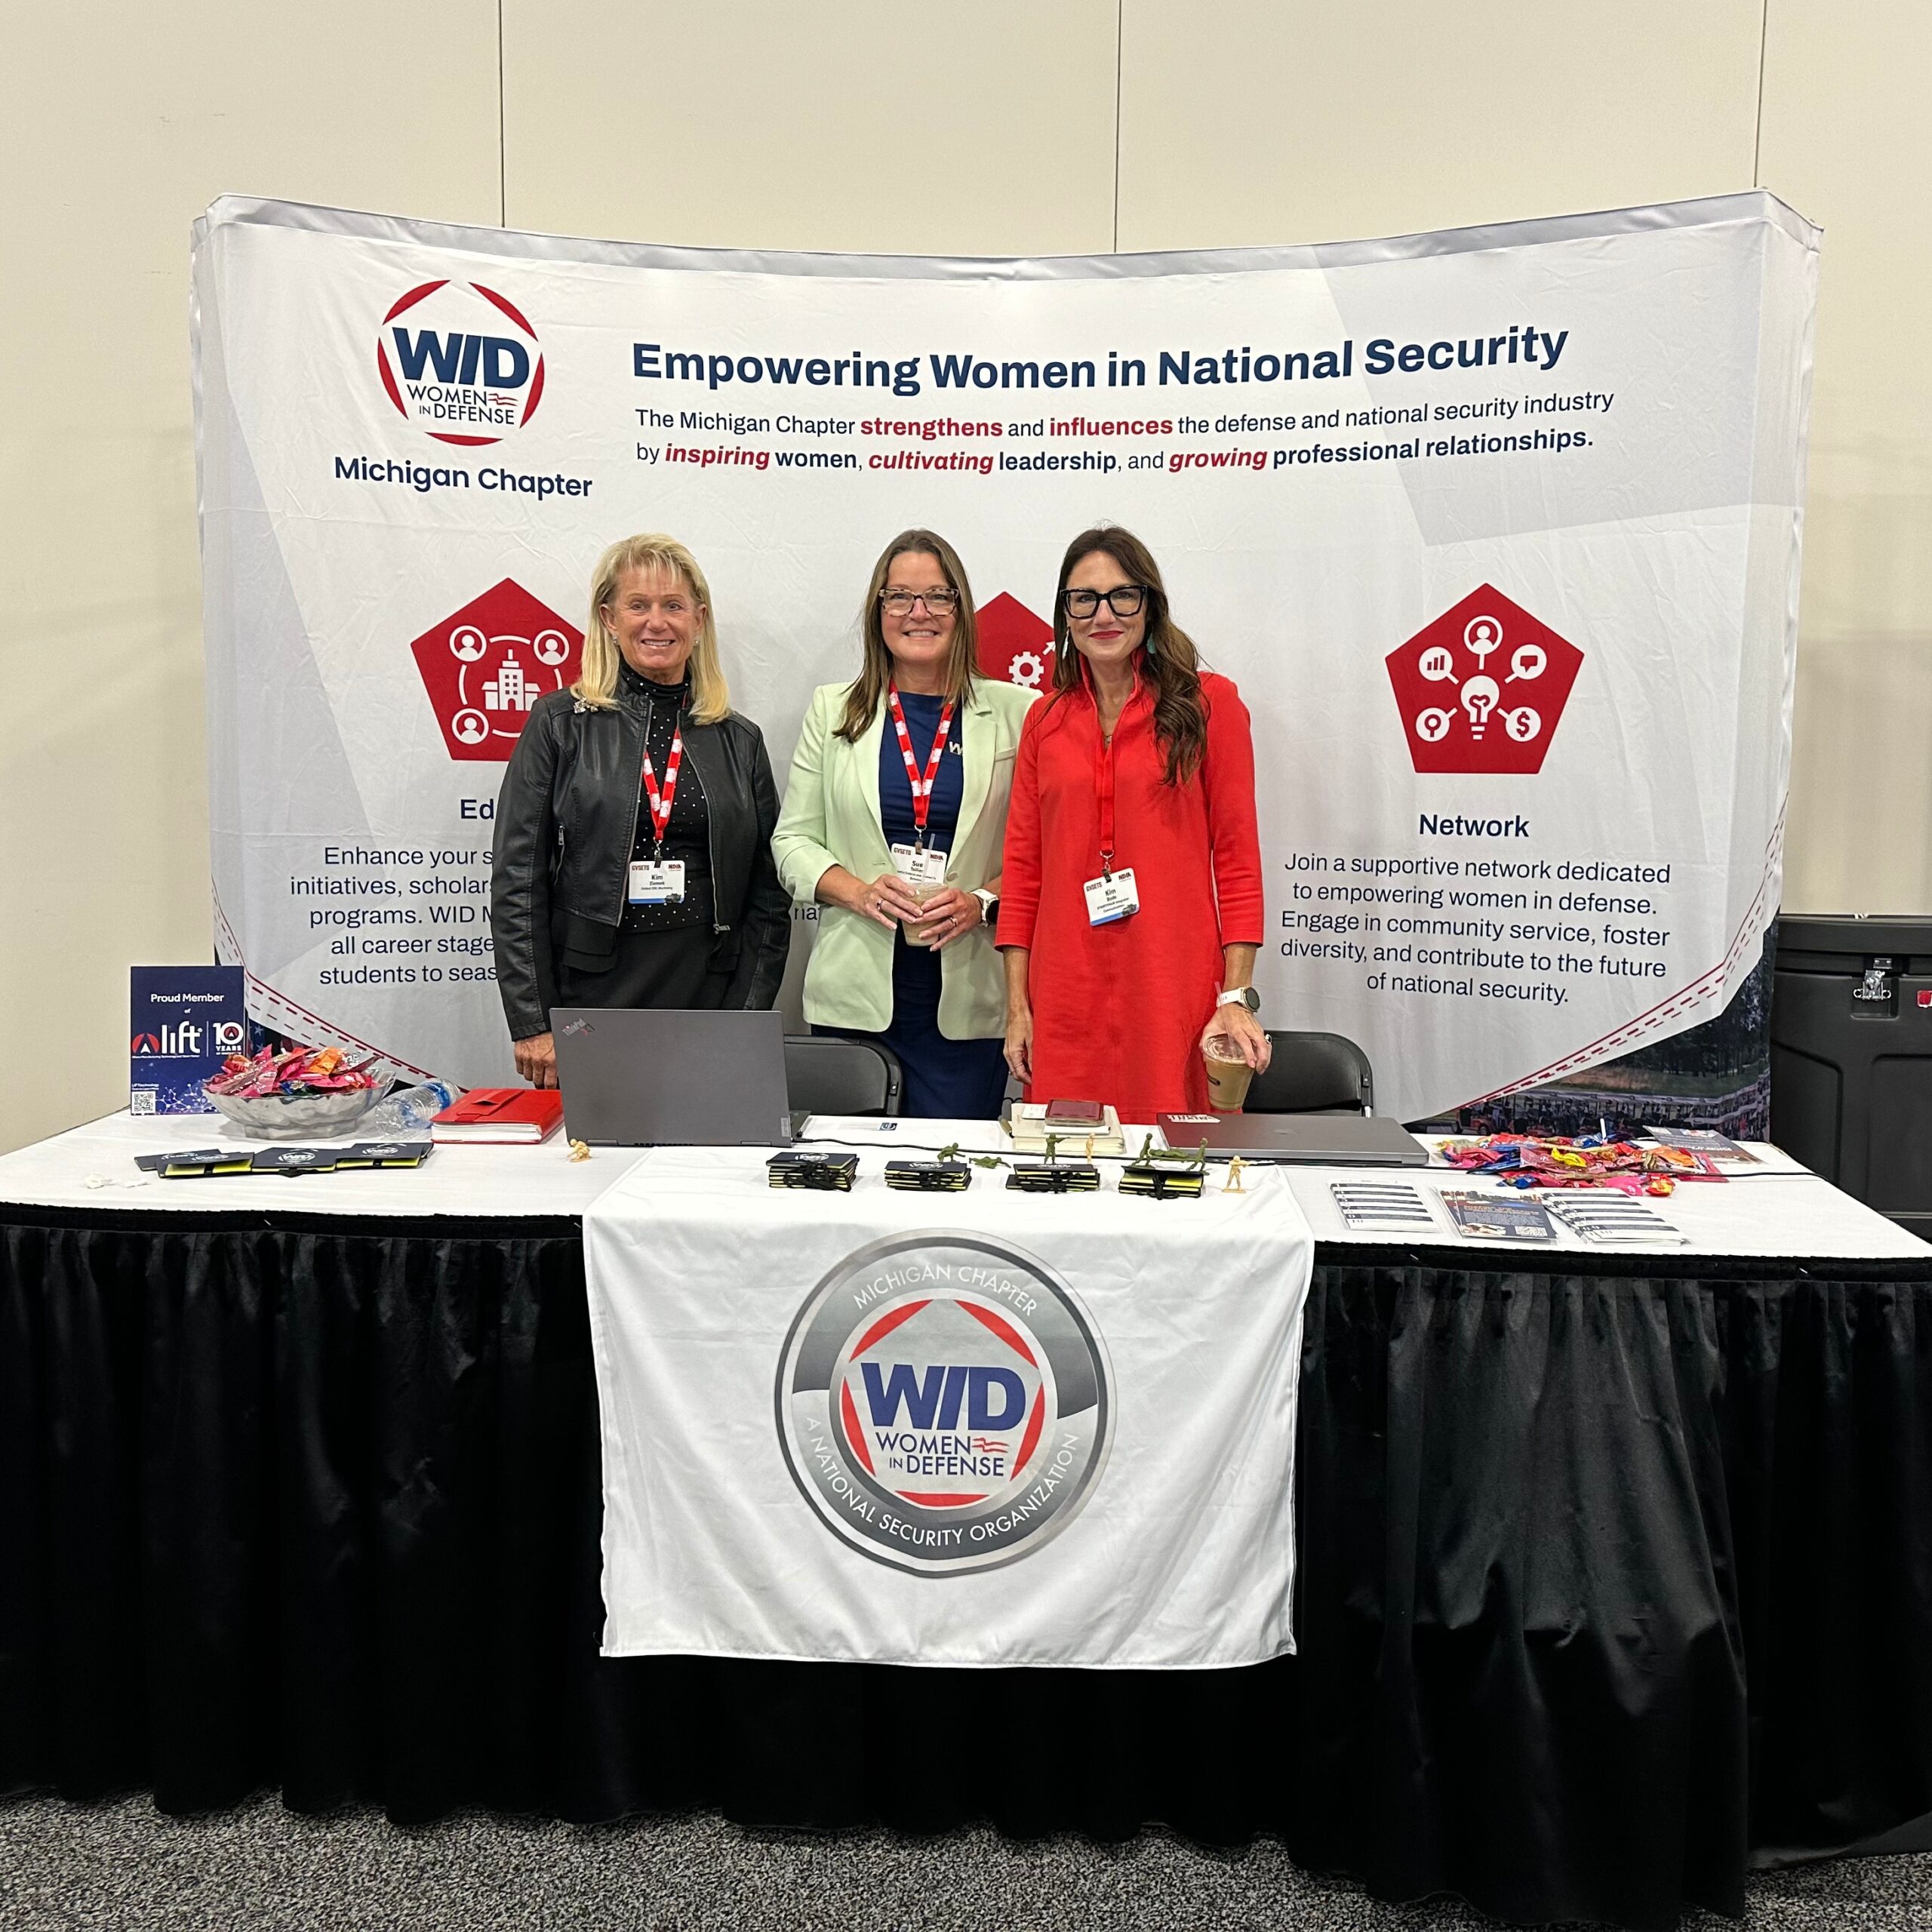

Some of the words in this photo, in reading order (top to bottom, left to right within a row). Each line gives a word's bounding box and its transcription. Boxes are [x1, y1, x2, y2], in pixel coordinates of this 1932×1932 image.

[392, 328, 530, 389] WID
[633, 343, 921, 397] Empowering
[929, 354, 1095, 389] Women
[1108, 351, 1146, 387] in
[1158, 340, 1353, 386] National
[1365, 326, 1569, 375] Security
[406, 383, 488, 407] WOMEN
[419, 405, 431, 415] IN
[434, 403, 515, 425] DEFENSE
[635, 408, 674, 428] The
[680, 411, 770, 435] Michigan
[776, 415, 856, 438] Chapter
[860, 417, 1003, 441] strengthens
[1008, 419, 1044, 437] and
[1050, 417, 1173, 436] influences
[1177, 416, 1210, 434] the
[1214, 414, 1296, 433] defense
[1301, 409, 1340, 429] and
[1346, 403, 1428, 427] national
[1433, 397, 1519, 421] security
[1524, 391, 1615, 415] industry
[637, 442, 660, 465] by
[665, 442, 771, 470] inspiring
[774, 452, 862, 472] women,
[869, 451, 994, 475] cultivating
[999, 451, 1121, 474] leadership,
[1128, 451, 1164, 469] and
[1168, 448, 1268, 473] growing
[1273, 438, 1420, 469] professional
[1426, 428, 1593, 457] relationships.
[334, 456, 469, 493] Michigan
[478, 468, 593, 501] Chapter
[1420, 814, 1530, 838] Network
[325, 846, 423, 865] Enhance
[429, 851, 478, 869] your
[1284, 853, 1327, 871] Join
[1333, 857, 1346, 872] a
[1351, 857, 1459, 878] supportive
[1465, 860, 1552, 879] network
[1557, 860, 1670, 884] dedicated
[291, 876, 402, 897] initiatives,
[408, 875, 492, 894] scholar
[1293, 882, 1312, 900] to
[1317, 885, 1444, 909] empowering
[1448, 891, 1527, 909] women
[1534, 890, 1552, 910] in
[1558, 891, 1657, 915] defense.
[310, 909, 423, 929] programs.
[429, 906, 475, 924] WID
[1281, 910, 1359, 934] Engage
[1364, 912, 1381, 931] in
[1387, 918, 1505, 942] community
[1509, 921, 1595, 946] service,
[1603, 924, 1670, 946] foster
[331, 936, 355, 955] all
[361, 939, 432, 954] career
[1281, 938, 1367, 963] diversity,
[1373, 944, 1412, 962] and
[1417, 948, 1524, 969] contribute
[1530, 952, 1552, 971] to
[1557, 953, 1593, 974] the
[1598, 955, 1666, 977] future
[319, 965, 416, 985] students
[421, 965, 443, 983] to
[448, 967, 497, 981] seas
[1367, 972, 1387, 990] of
[1392, 974, 1473, 996] national
[1478, 982, 1568, 1006] security.
[151, 993, 181, 1002] Proud
[183, 993, 225, 1002] Member
[162, 1020, 201, 1054] lift
[213, 1021, 244, 1045] 10
[854, 1263, 951, 1309] MICHIGAN
[958, 1266, 1038, 1315] CHAPTER
[861, 1362, 1026, 1431] WID
[807, 1417, 821, 1431] A
[875, 1432, 971, 1454] WOMEN
[811, 1437, 876, 1523] NATIONAL
[889, 1457, 903, 1469] IN
[906, 1456, 1004, 1476] DEFENSE
[970, 1433, 1079, 1540] ORGANIZATION
[879, 1514, 963, 1546] SECURITY
